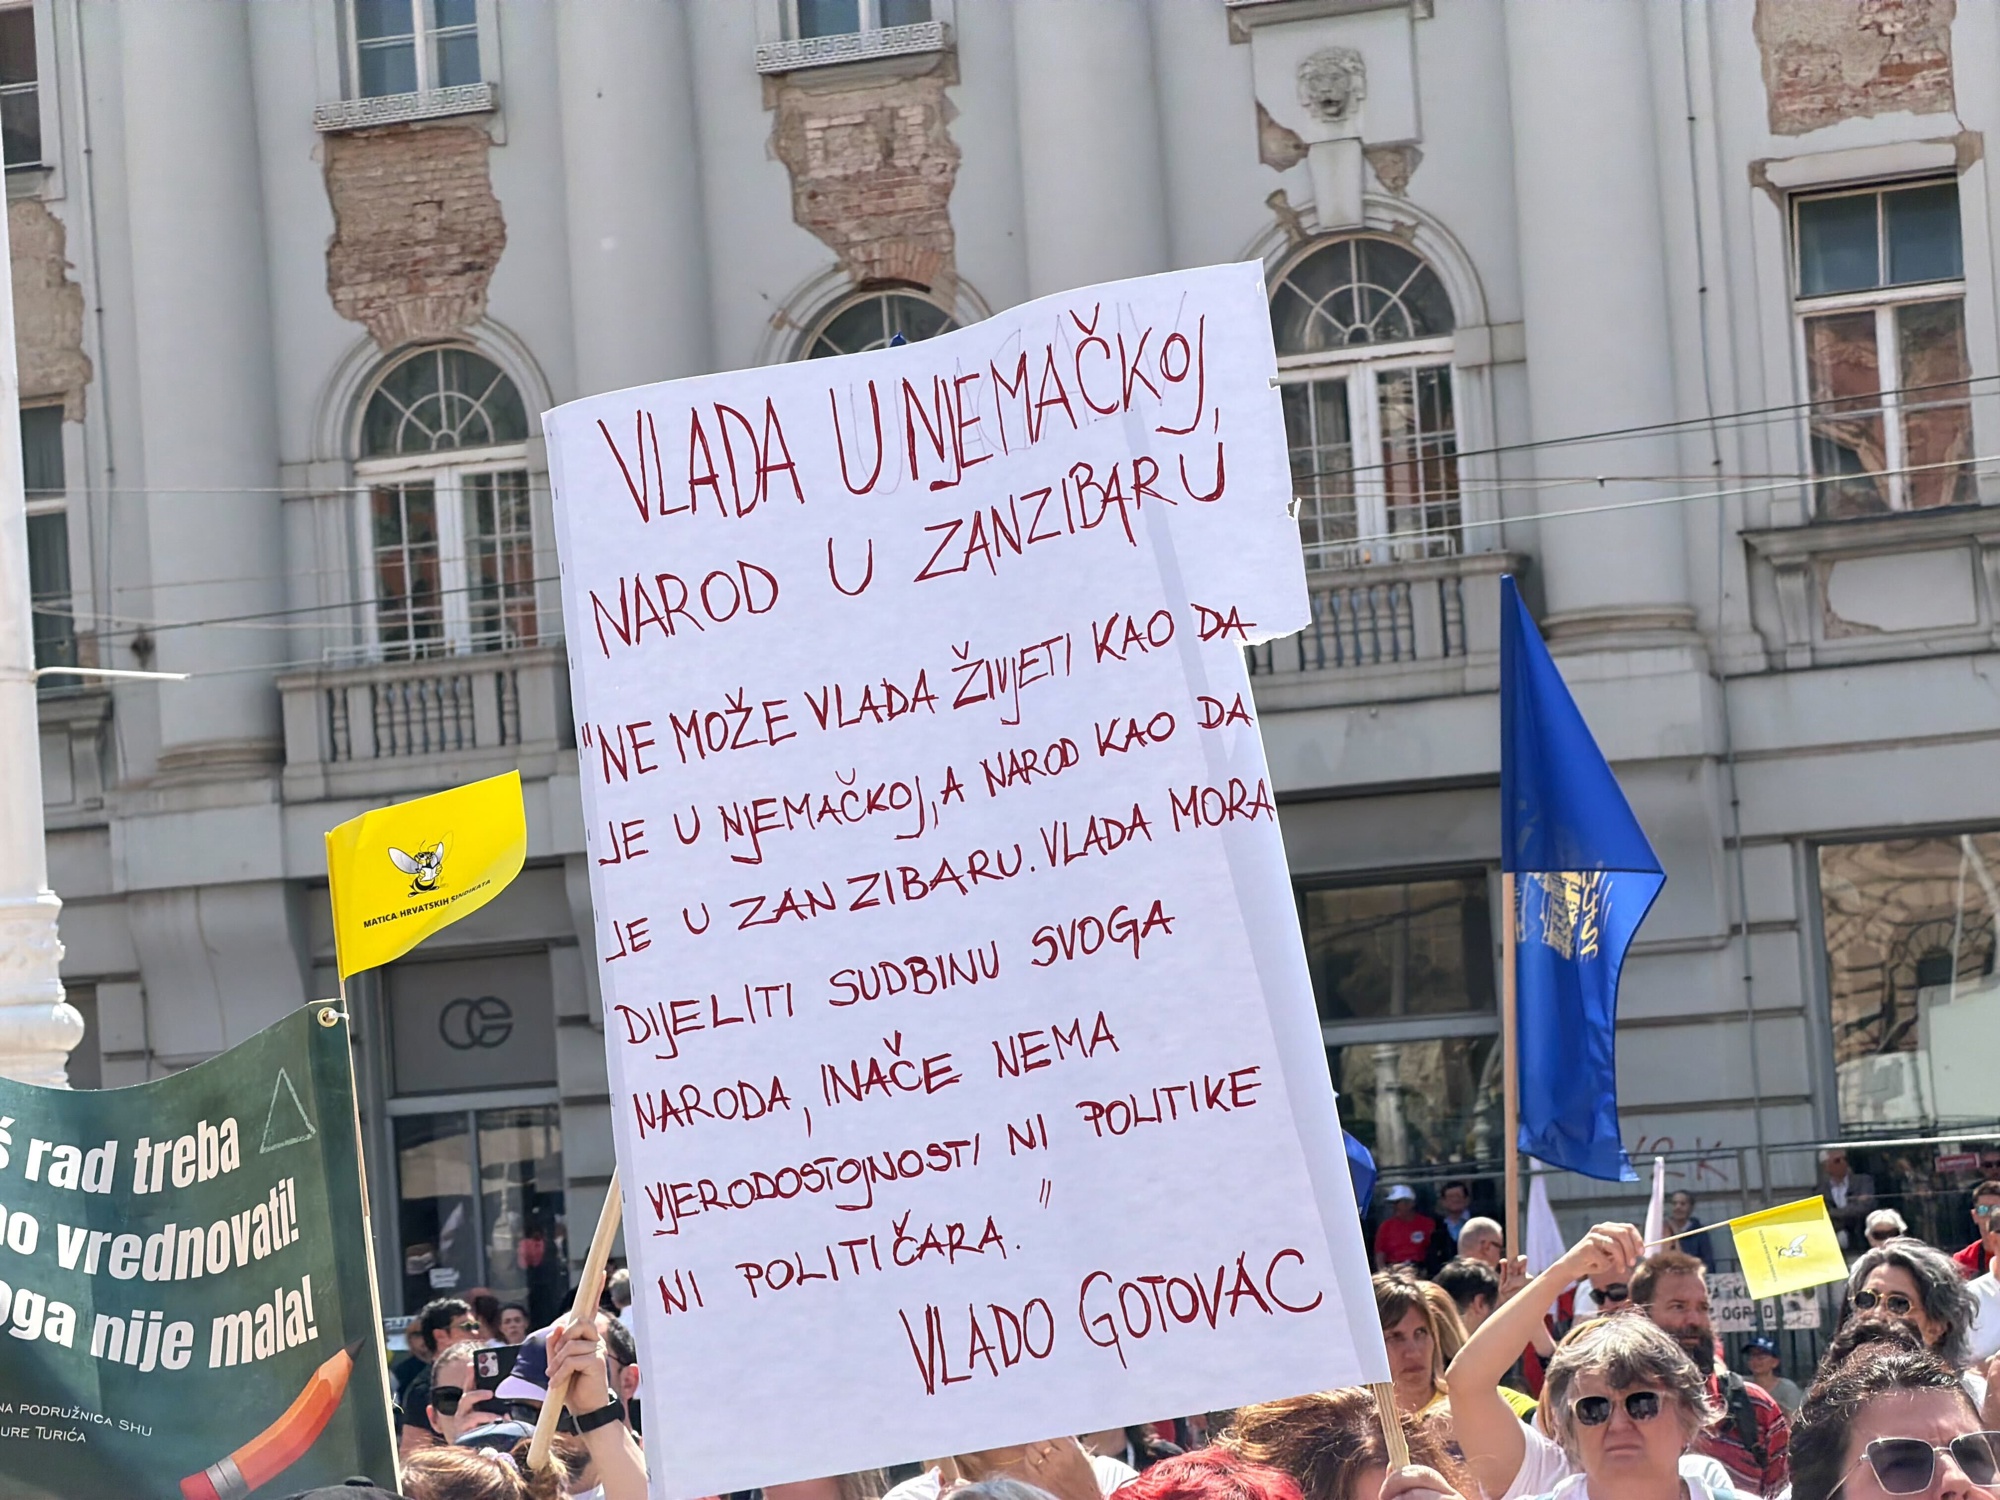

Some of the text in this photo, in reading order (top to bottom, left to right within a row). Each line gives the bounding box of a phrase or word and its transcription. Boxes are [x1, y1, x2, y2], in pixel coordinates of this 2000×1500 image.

[598, 301, 1219, 524] VLADA U NJEMAČKOJ,
[591, 560, 779, 656] NAROD
[827, 539, 873, 596] U
[669, 688, 797, 763] MOŽE
[805, 669, 937, 731] VLADA
[952, 635, 1071, 726] ŽIVJETI
[1092, 609, 1175, 663] KAO
[1192, 604, 1256, 642] DA
[599, 694, 1250, 865] JE U NJEMAČKOJ, A NAROD KAO DA
[363, 912, 398, 928] MATICA
[400, 898, 450, 918] HRVATSKIH
[607, 917, 651, 961] JE
[683, 904, 710, 935] U
[1041, 804, 1151, 867] VLADA
[1169, 777, 1274, 832] MORA
[614, 900, 1175, 1060] DIJELITI SUDBINU SVOGA
[821, 1031, 961, 1105] INAČE
[992, 1012, 1119, 1078] NEMA
[24, 1137, 119, 1195] rad
[132, 1117, 241, 1195] treba
[646, 1066, 1261, 1237] VJERODOSTOJNOSTI NI POLITIKE
[57, 1177, 299, 1282] vrednovati!
[90, 1309, 195, 1373] nije
[208, 1274, 319, 1369] mala!
[658, 1271, 704, 1314] NI
[899, 1248, 1323, 1395] VLADO GOTOVAC
[19, 1403, 113, 1427] PODRUŽNICA
[118, 1419, 153, 1437] SHU
